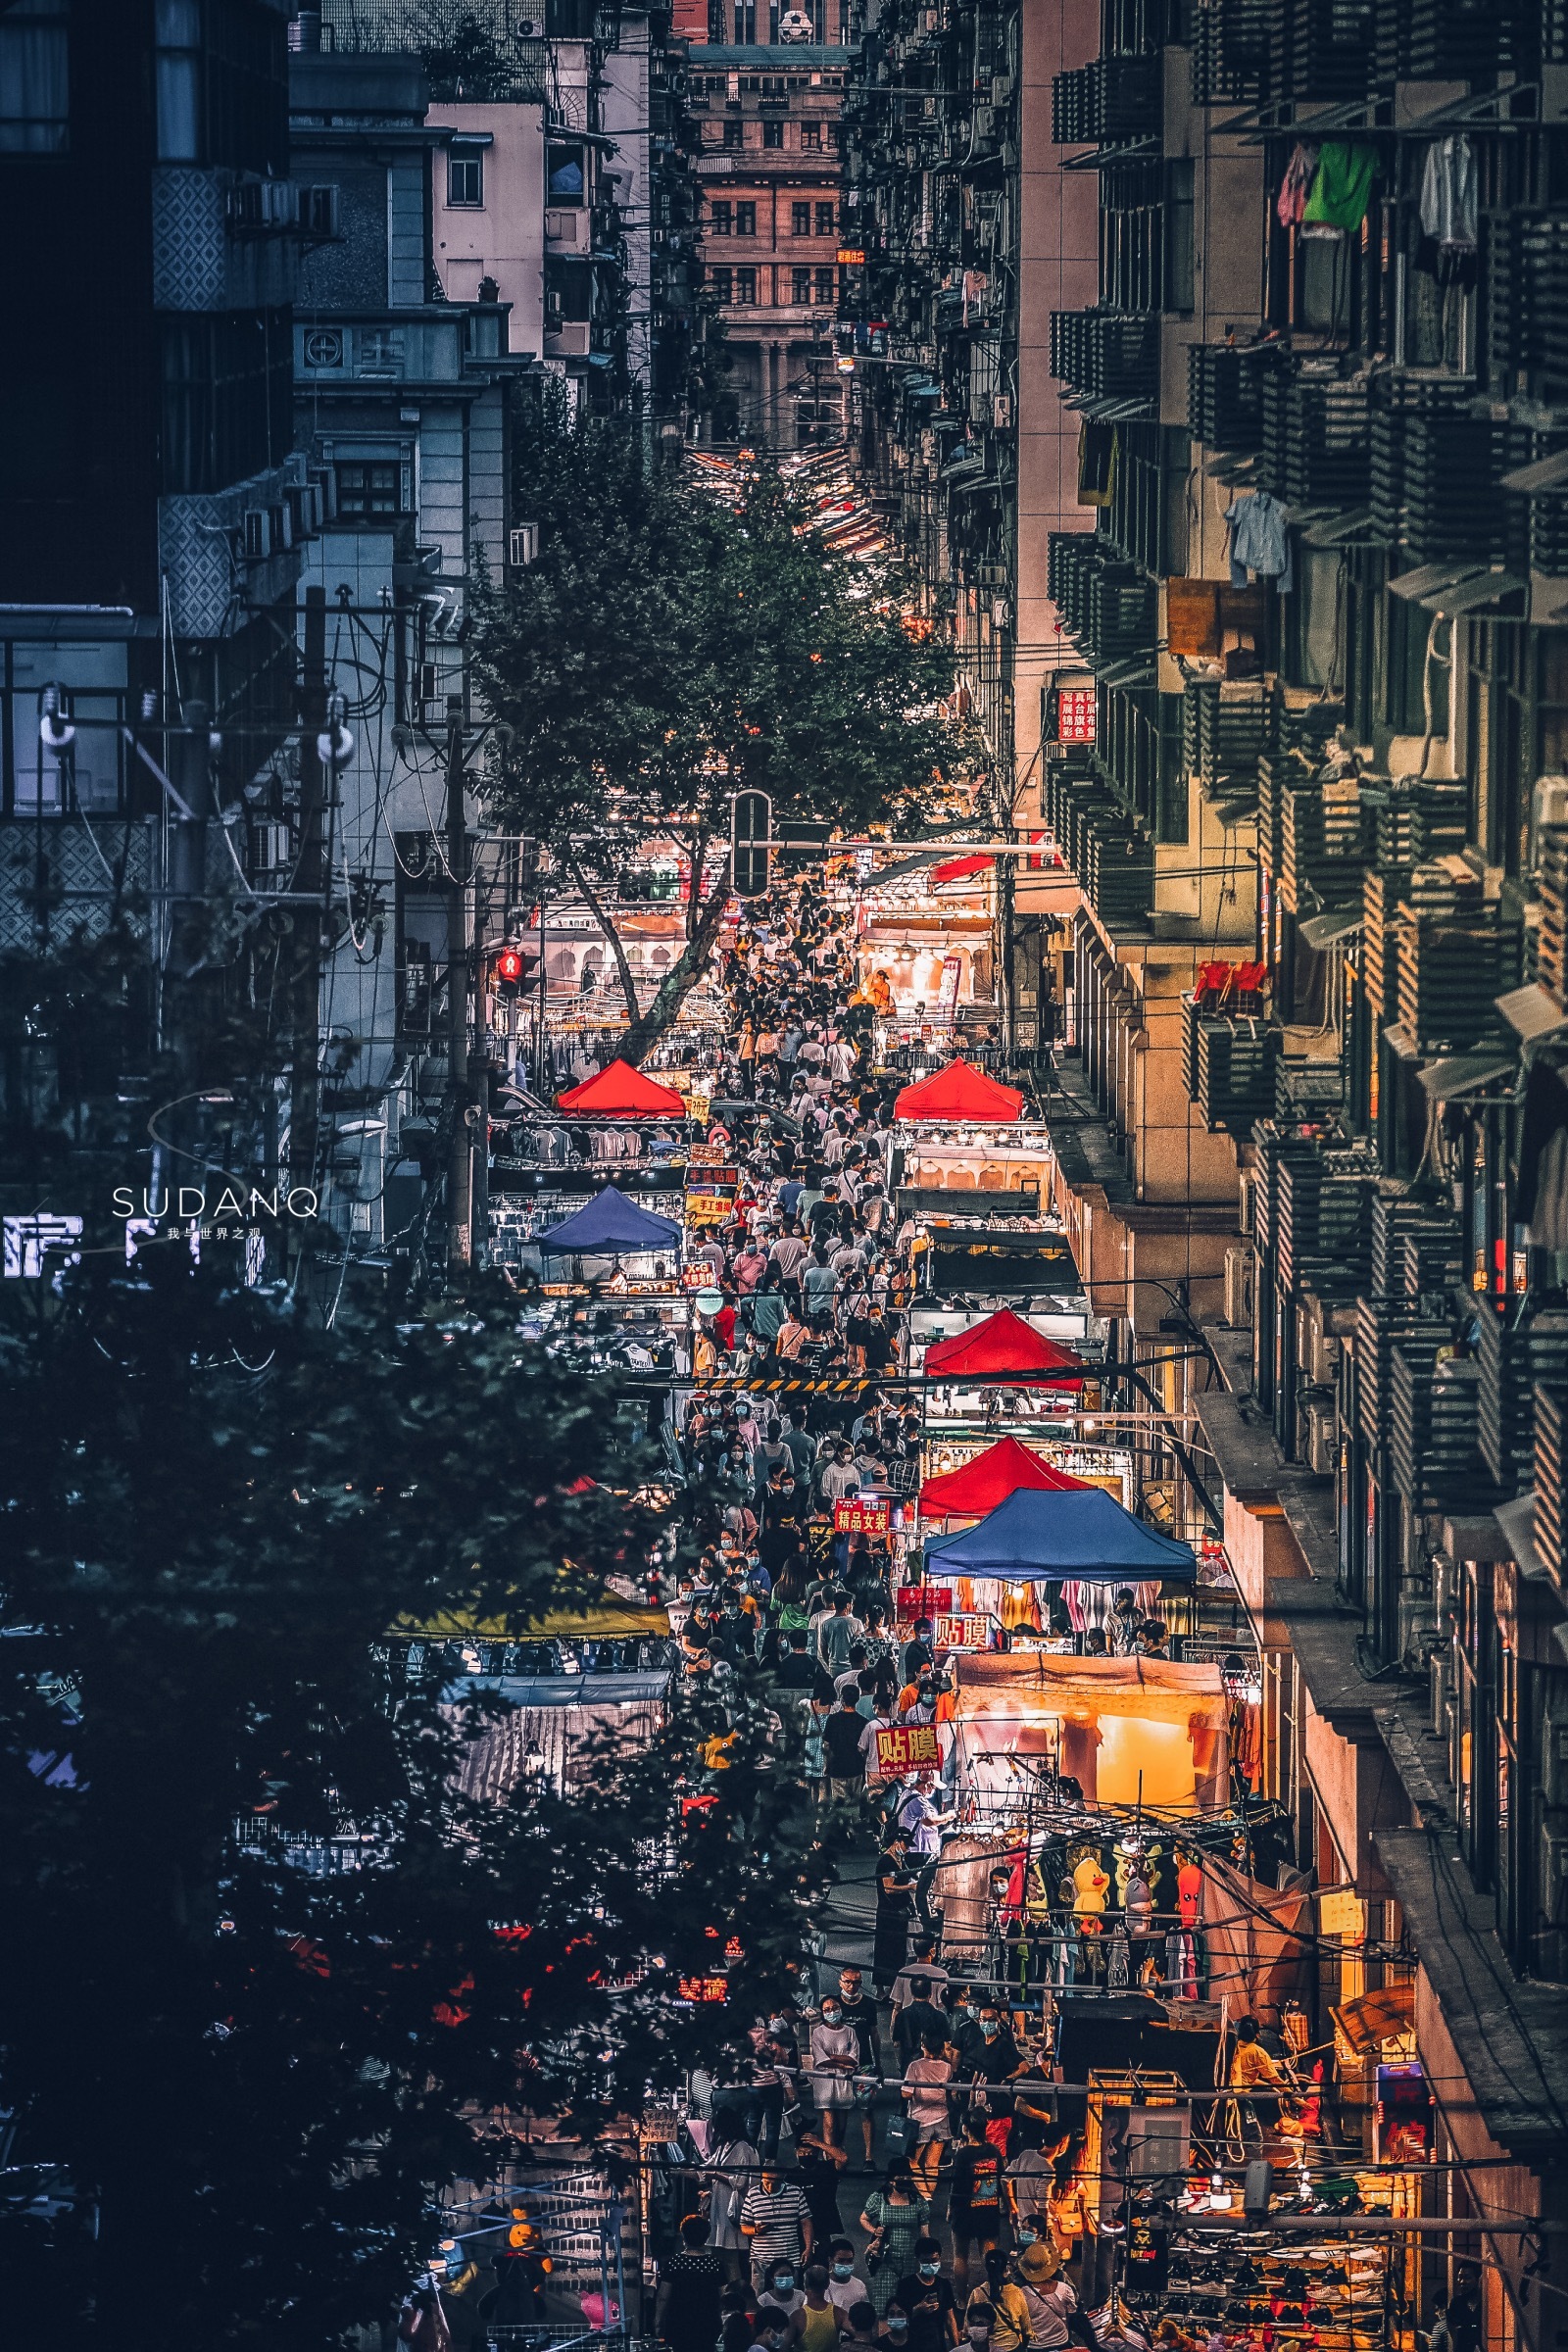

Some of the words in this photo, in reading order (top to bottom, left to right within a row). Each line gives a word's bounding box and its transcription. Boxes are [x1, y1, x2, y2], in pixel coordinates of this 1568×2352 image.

[838, 1510, 887, 1531] 精品女装
[937, 1617, 987, 1646] 贴膜
[878, 1727, 938, 1765] 贴膜
